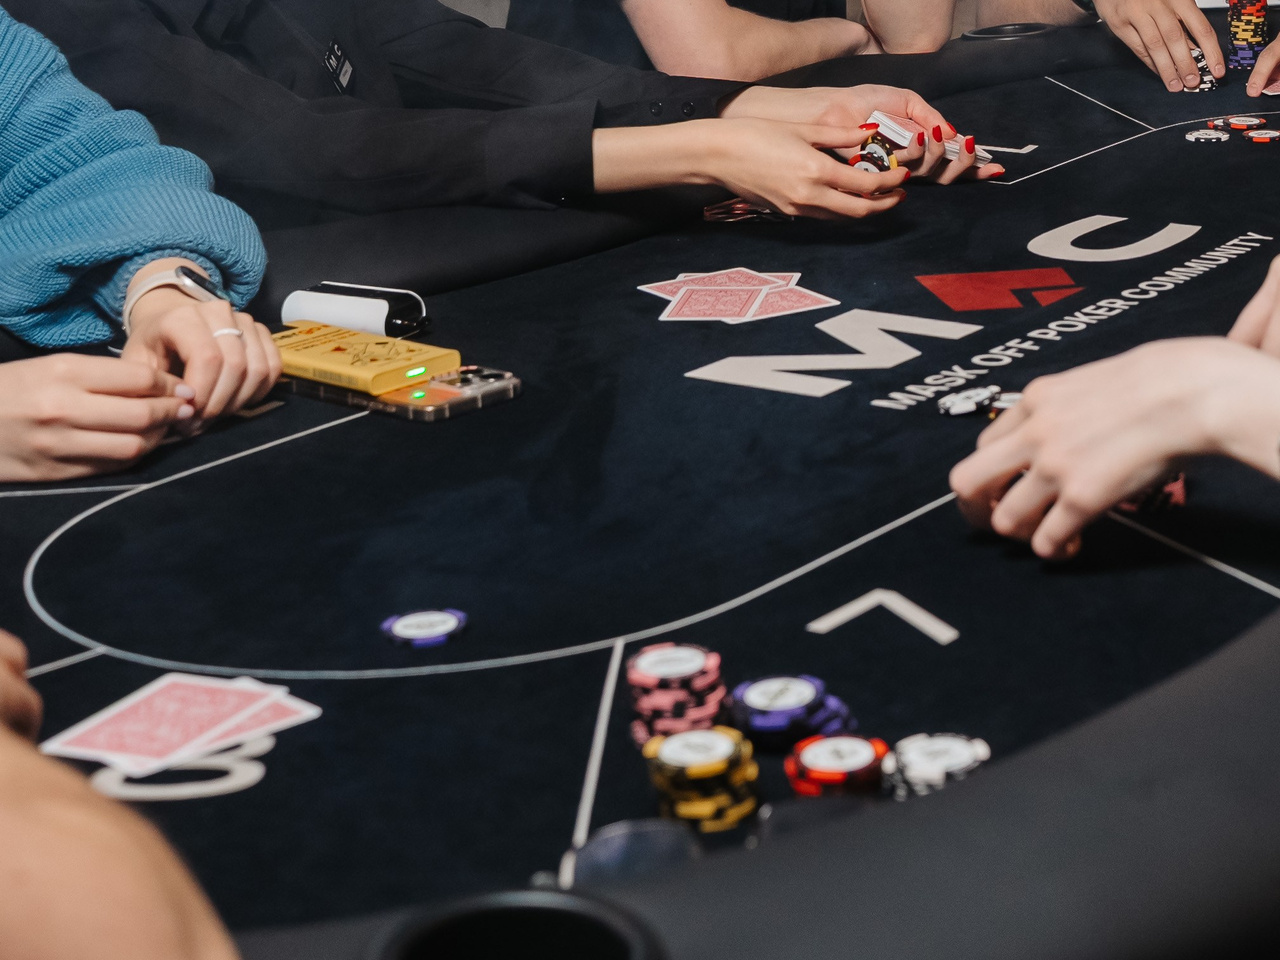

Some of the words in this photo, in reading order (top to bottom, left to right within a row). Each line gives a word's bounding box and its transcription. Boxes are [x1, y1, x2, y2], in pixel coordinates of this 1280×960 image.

[870, 364, 989, 411] MASK
[971, 338, 1041, 368] OFF
[1036, 298, 1140, 341] POKER
[1120, 231, 1274, 300] COMMUNITY
